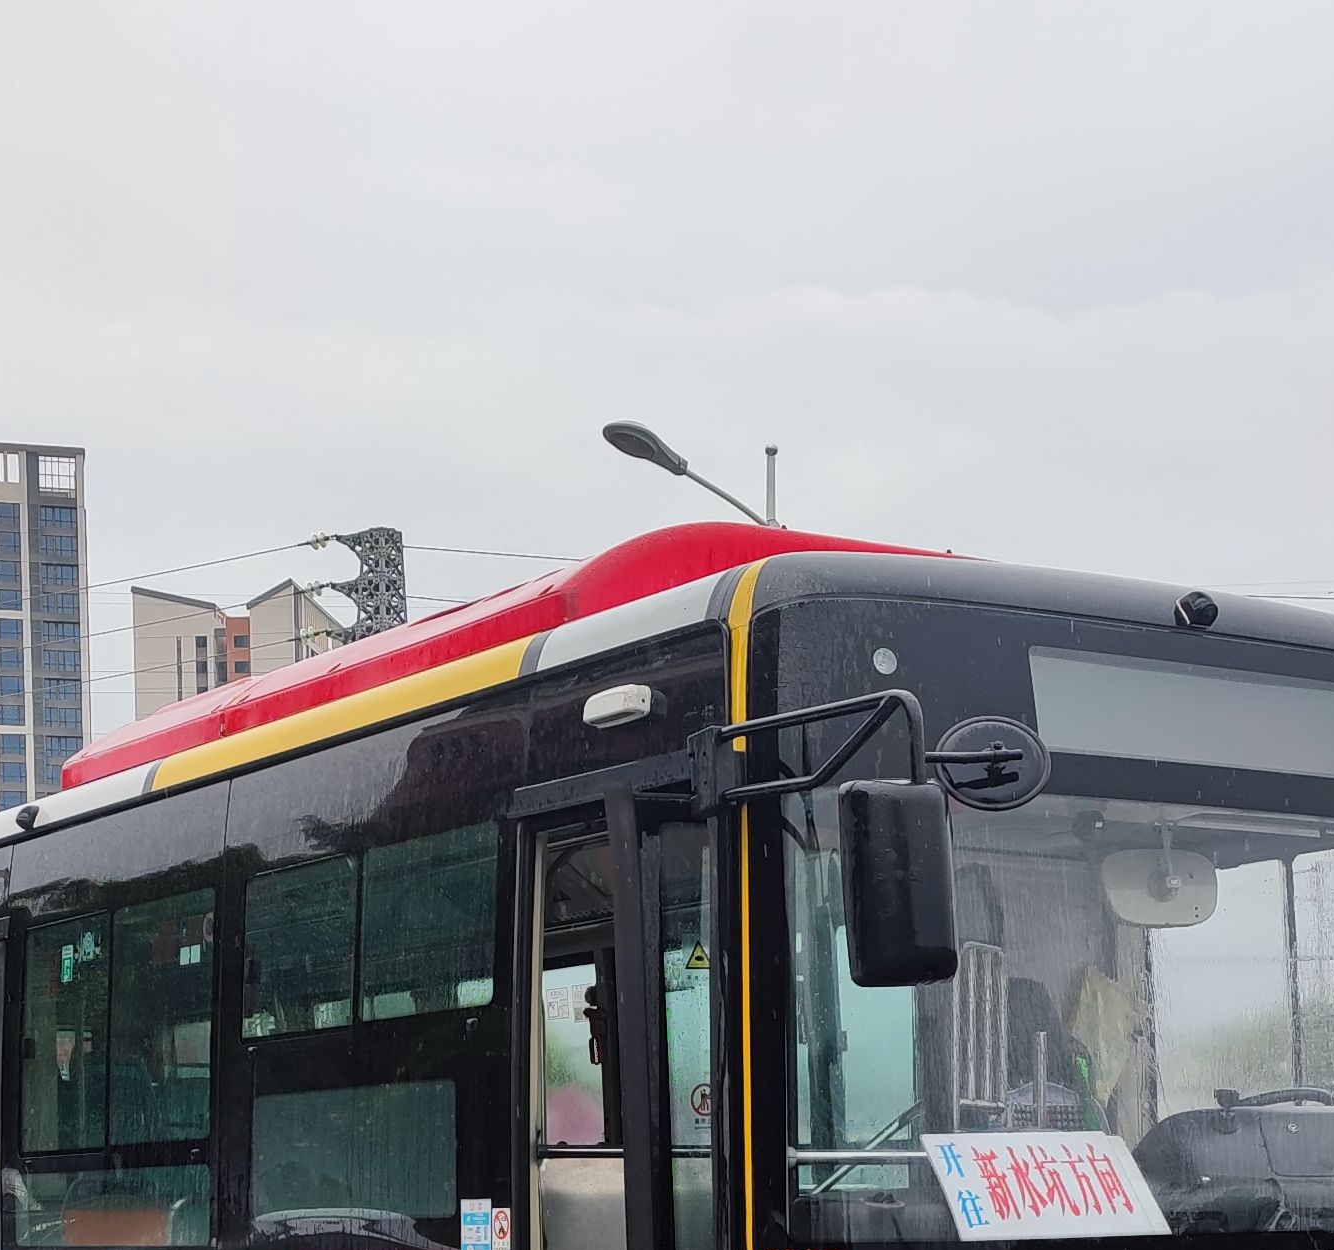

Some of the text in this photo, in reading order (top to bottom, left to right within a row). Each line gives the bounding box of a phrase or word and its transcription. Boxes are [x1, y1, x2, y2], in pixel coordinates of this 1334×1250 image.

[933, 1141, 990, 1229] 开往
[970, 1142, 1135, 1221] 新水坑方向
